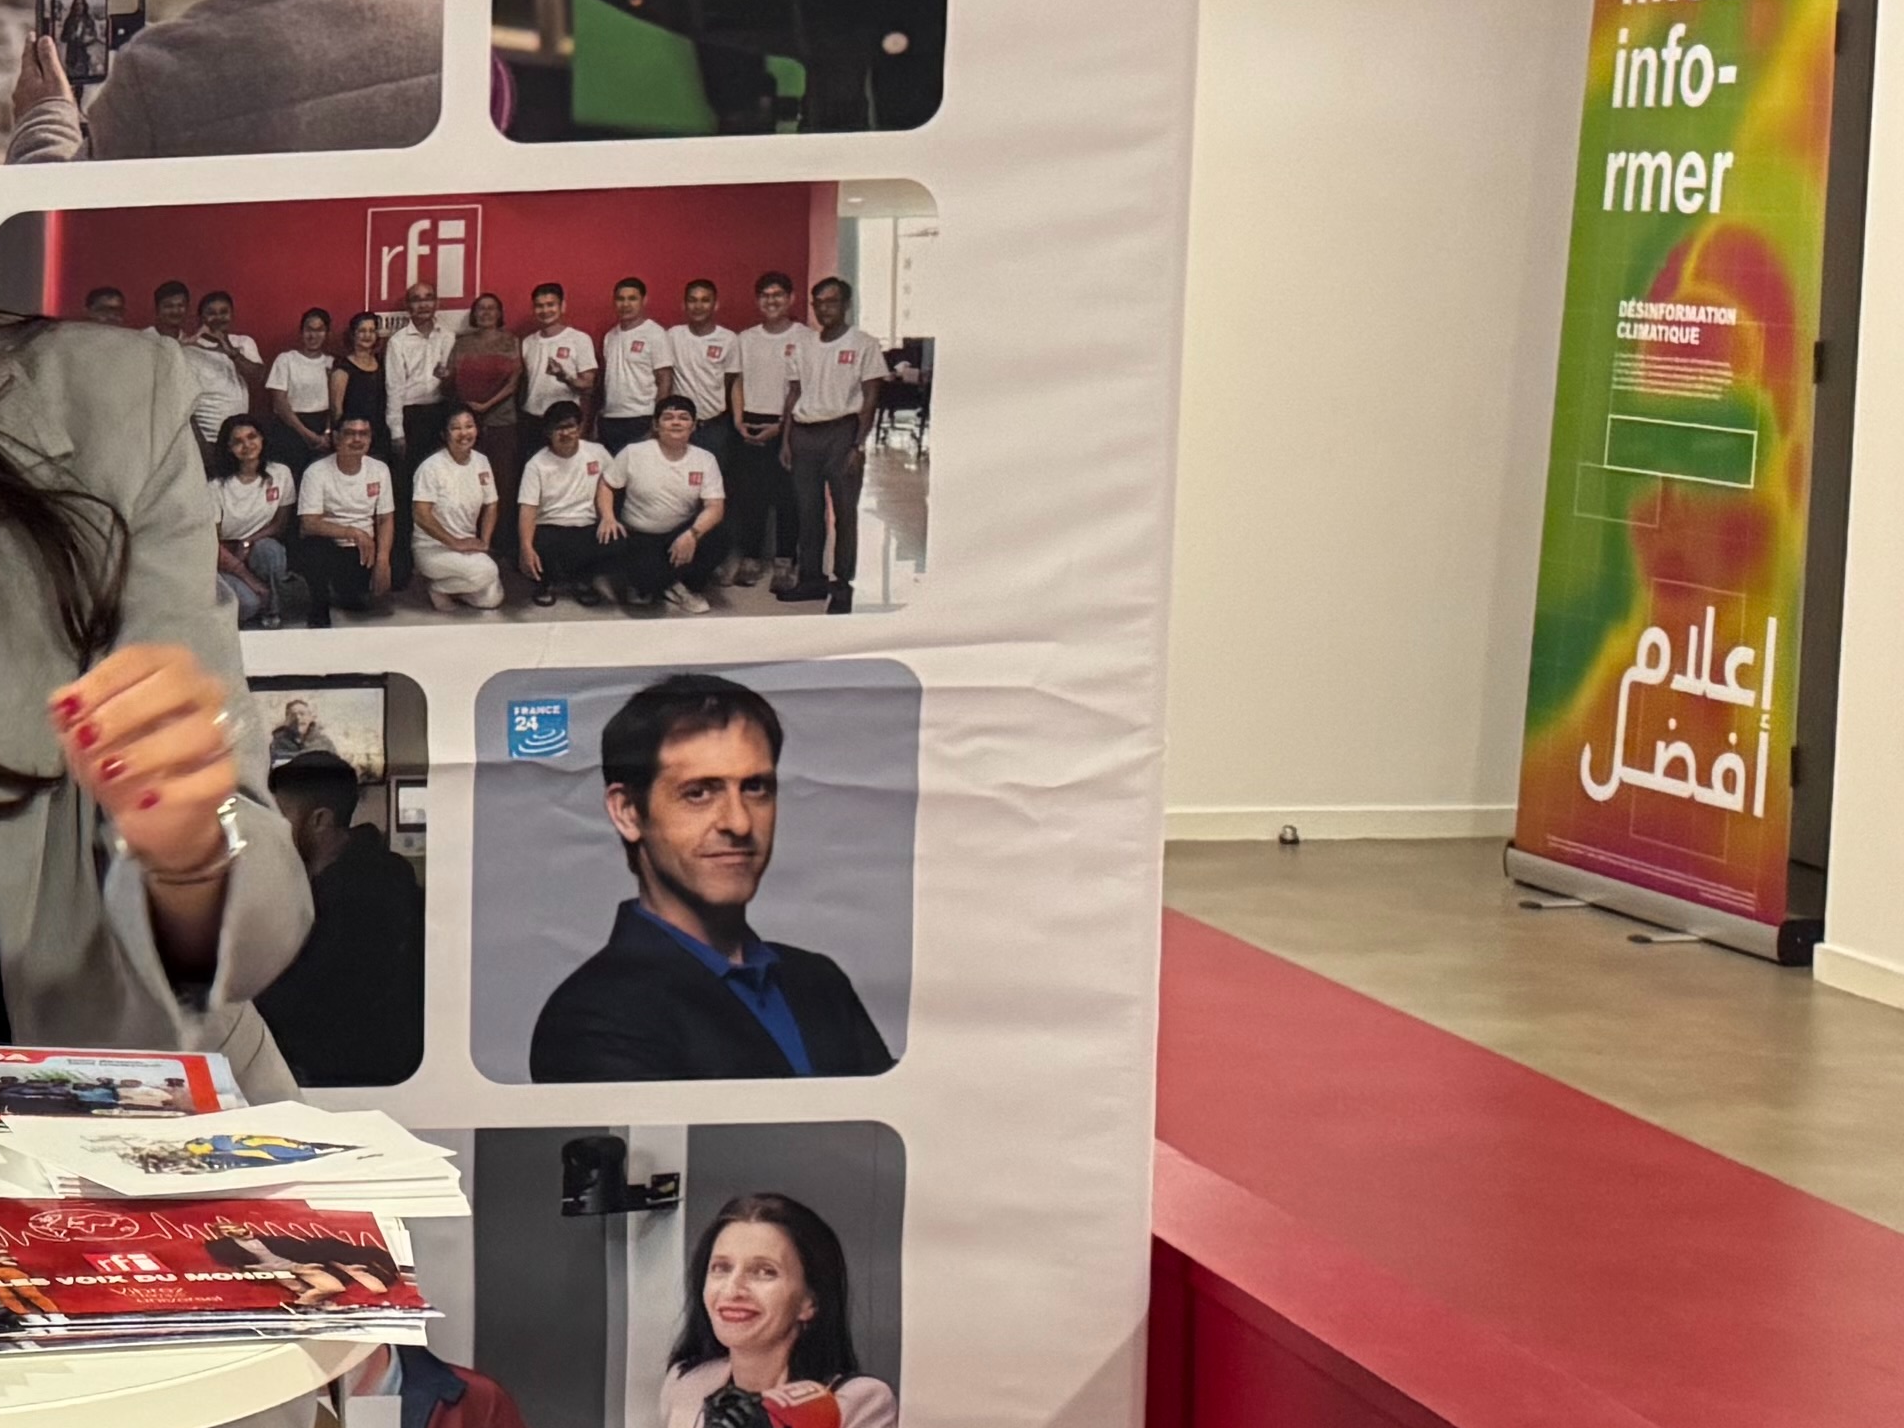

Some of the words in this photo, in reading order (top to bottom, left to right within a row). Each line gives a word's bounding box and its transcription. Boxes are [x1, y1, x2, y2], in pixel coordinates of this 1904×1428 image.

[1612, 23, 1738, 109] info-
[1602, 150, 1734, 215] rmer
[381, 219, 466, 301] rfi
[1618, 297, 1737, 326] DÉSINFORMATION
[1616, 321, 1701, 346] CLIMATIQUE
[514, 705, 561, 716] FRANCE
[514, 715, 539, 731] 24
[97, 1253, 162, 1272] rfi
[55, 1274, 129, 1285] VOIX
[133, 1273, 178, 1283] DU
[184, 1271, 297, 1283] MONDE
